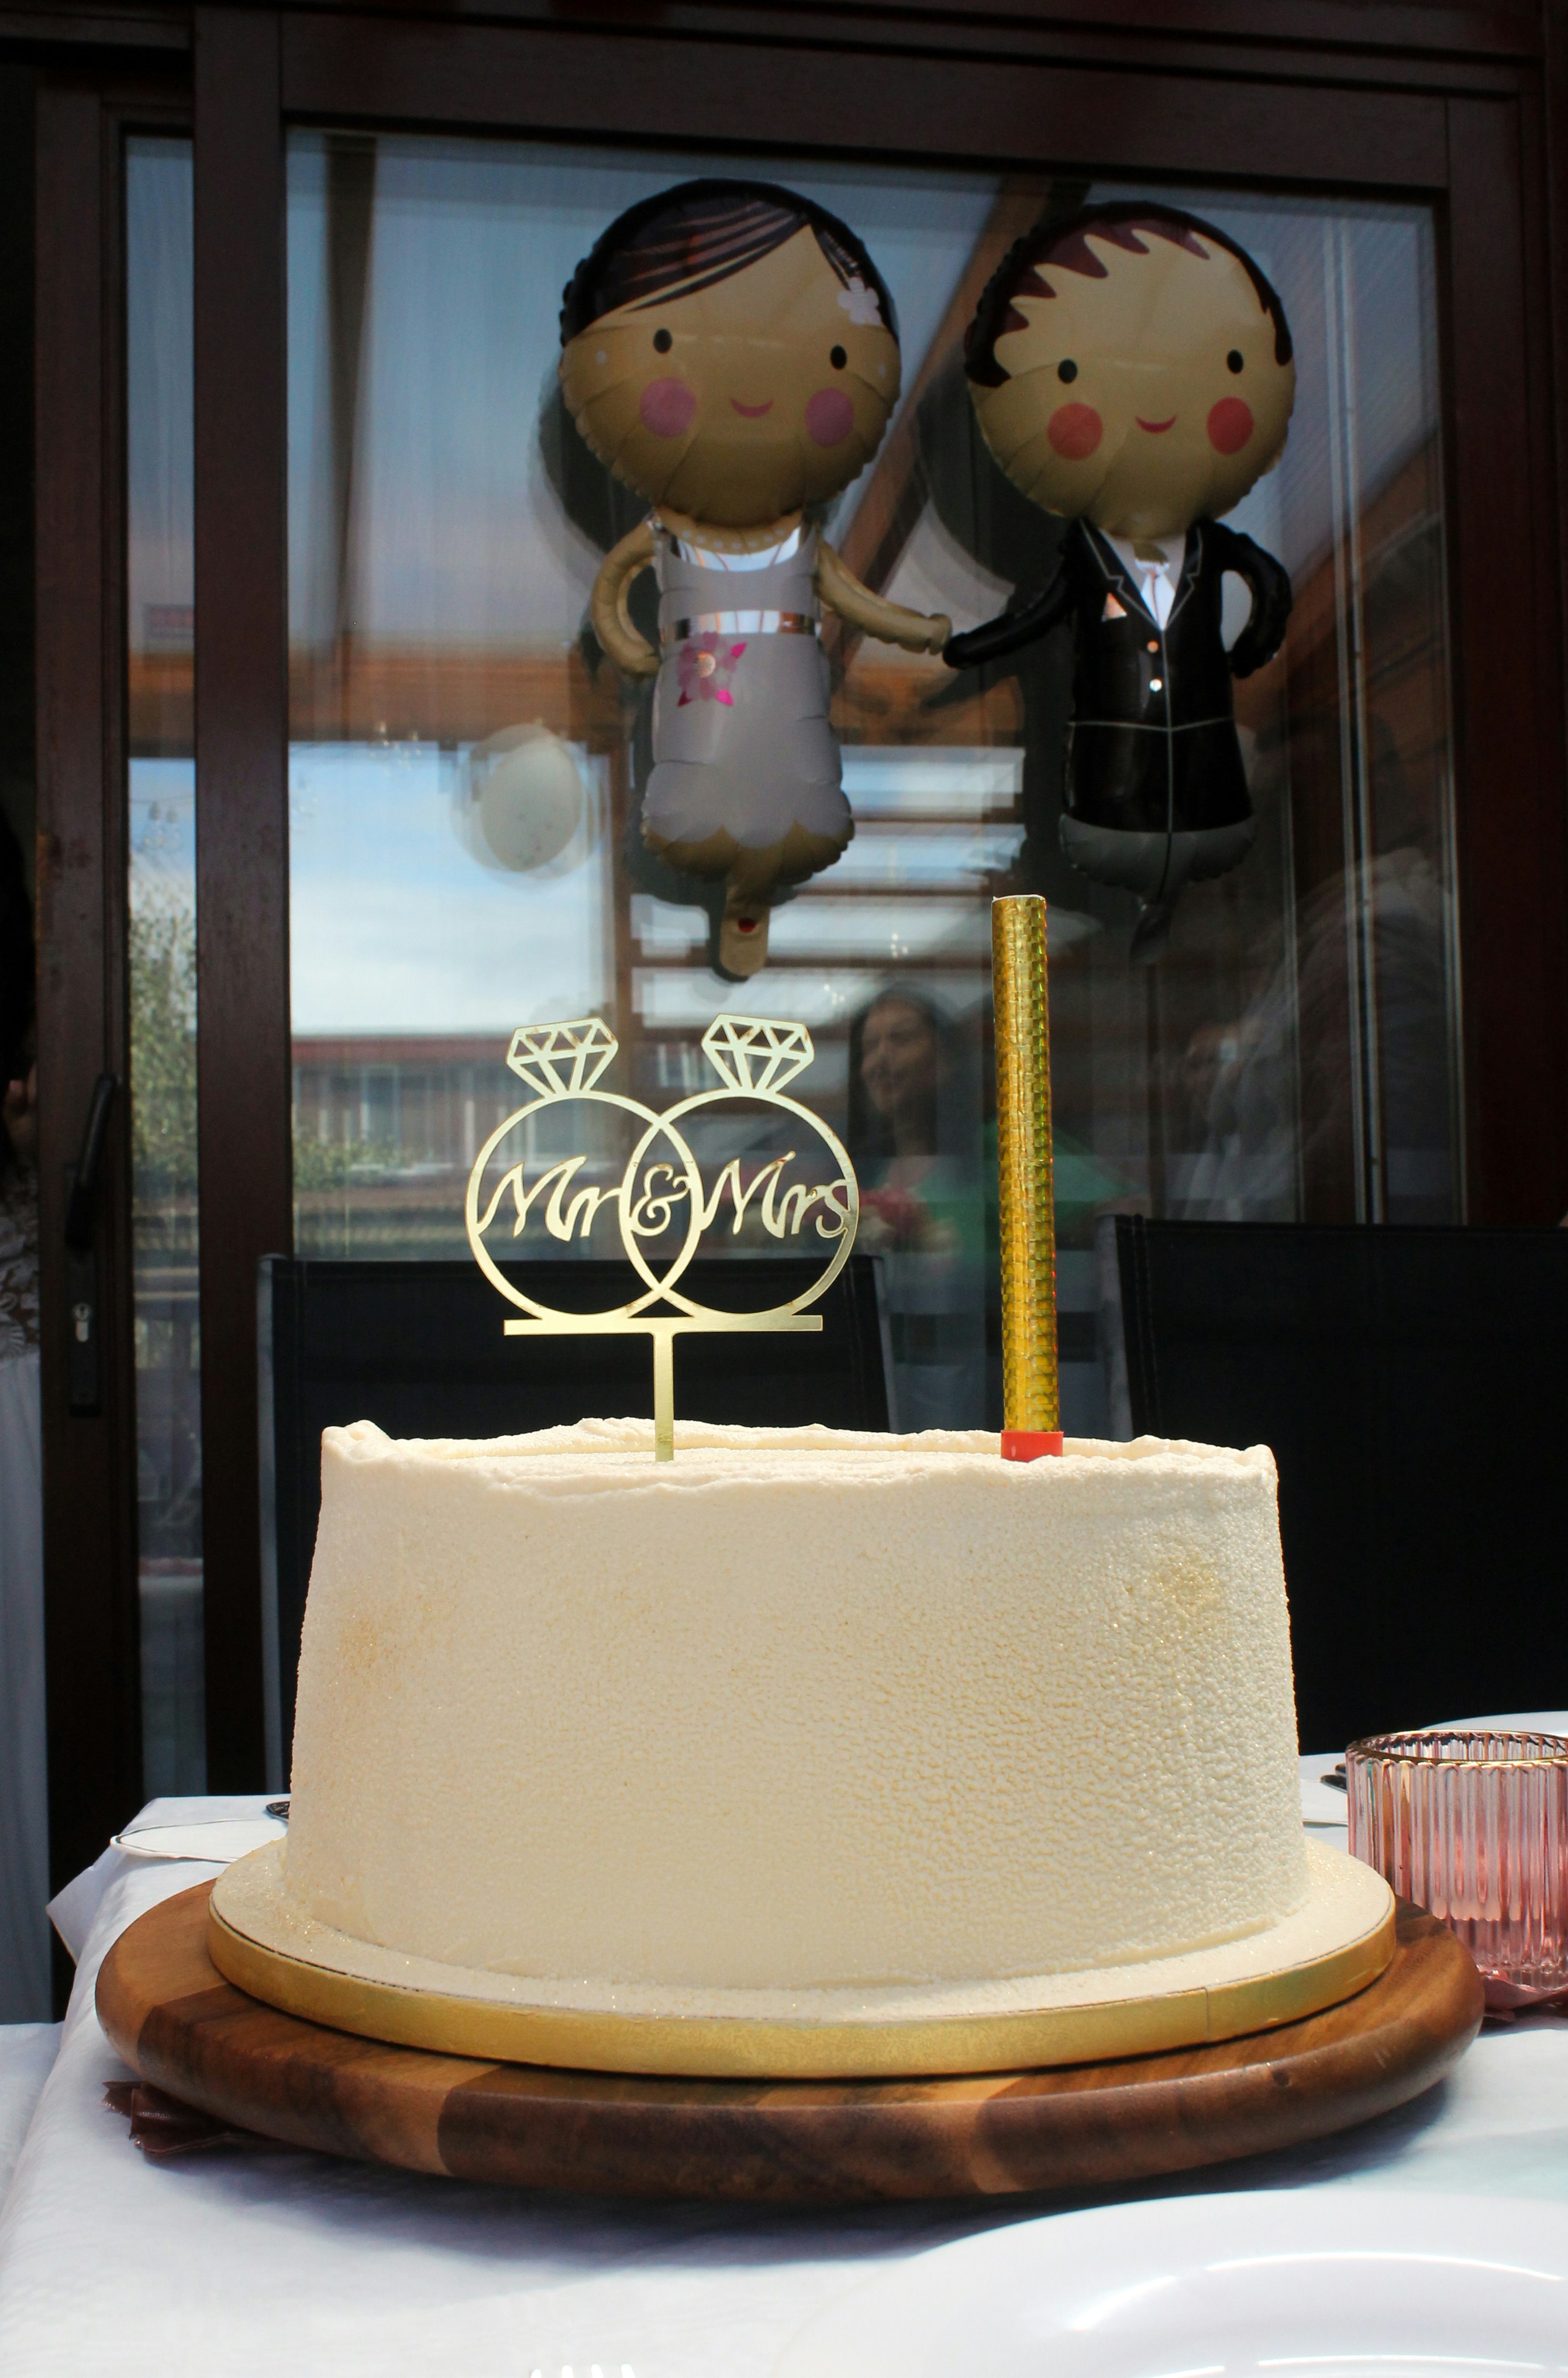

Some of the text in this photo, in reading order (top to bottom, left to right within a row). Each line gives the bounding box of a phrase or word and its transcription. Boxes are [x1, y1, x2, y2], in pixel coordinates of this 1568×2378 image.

[477, 1151, 850, 1242] Mr & Mrs
